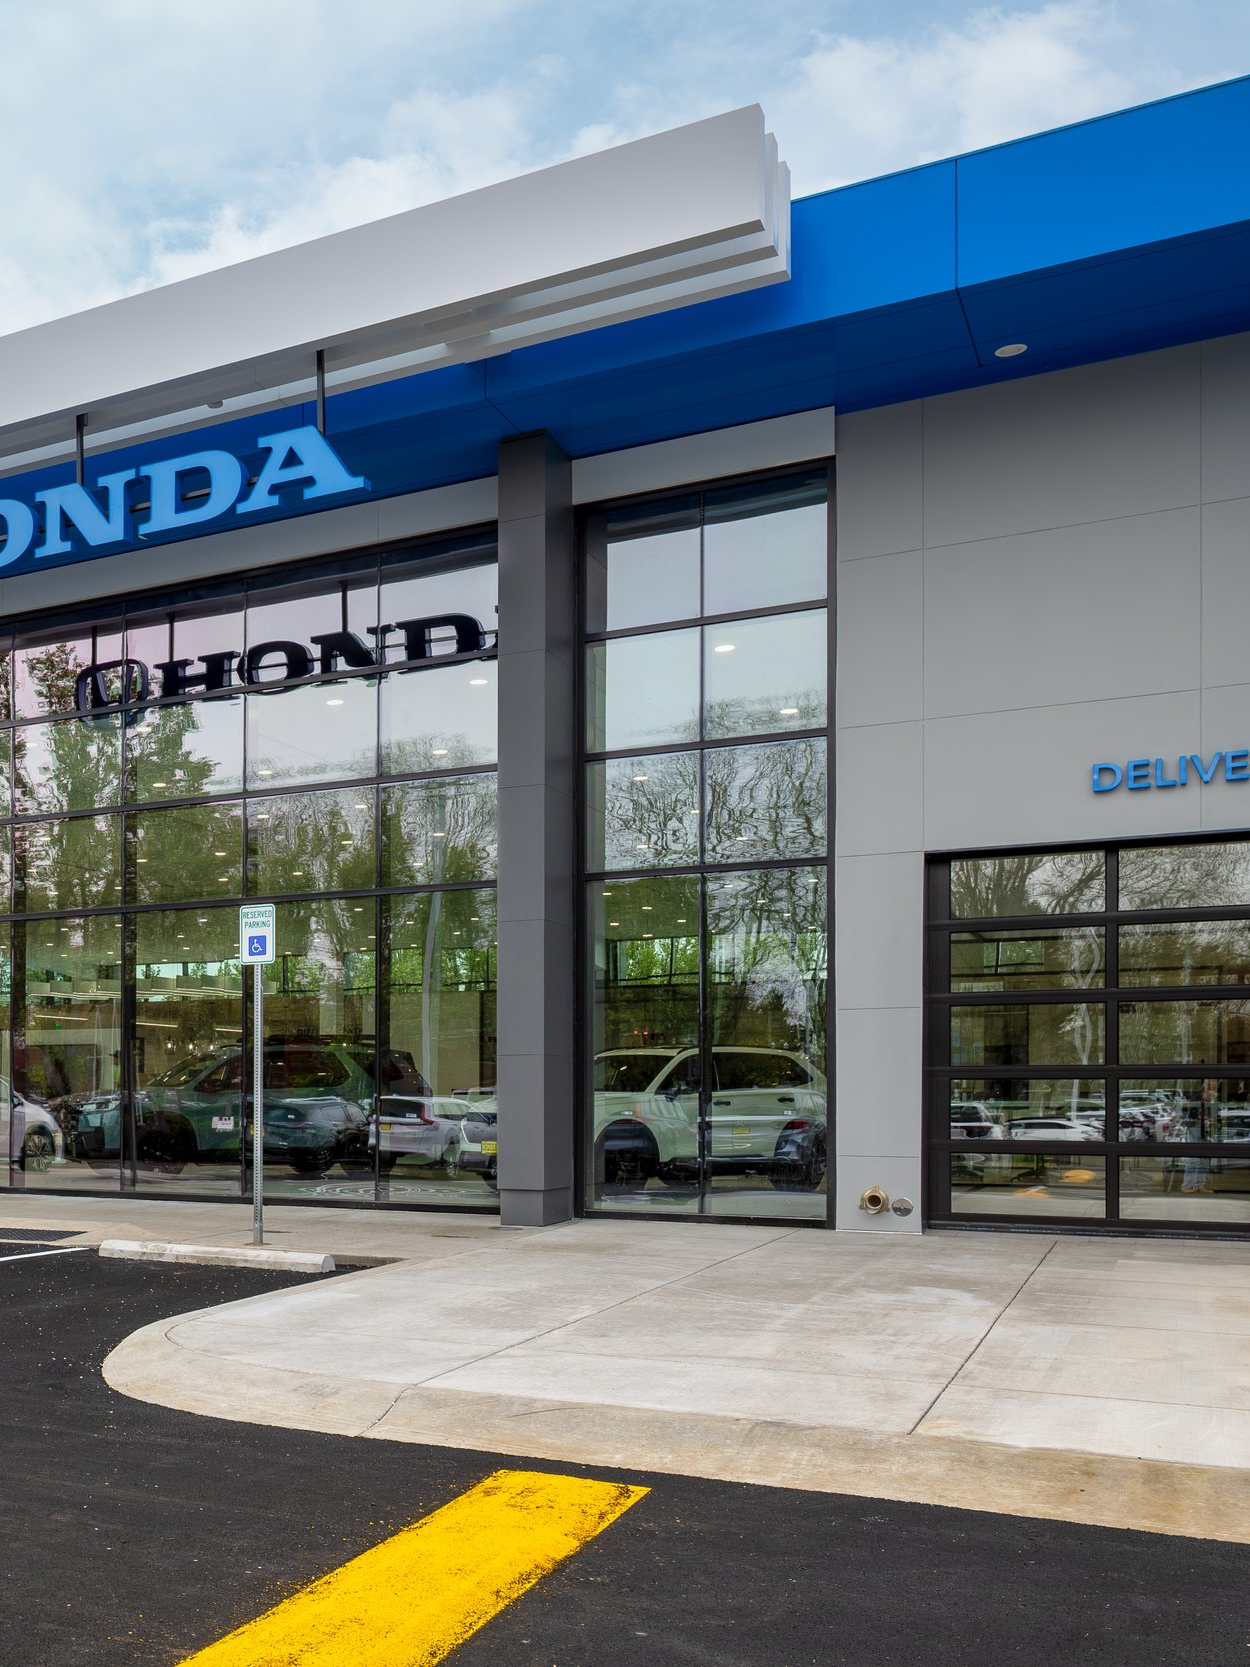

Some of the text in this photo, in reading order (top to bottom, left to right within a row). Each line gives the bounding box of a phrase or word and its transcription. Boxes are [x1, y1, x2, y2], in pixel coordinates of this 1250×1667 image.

[154, 606, 499, 702] HOND
[1092, 749, 1250, 793] DELIVE
[242, 910, 272, 919] RESERVED
[244, 920, 270, 929] PARKING
